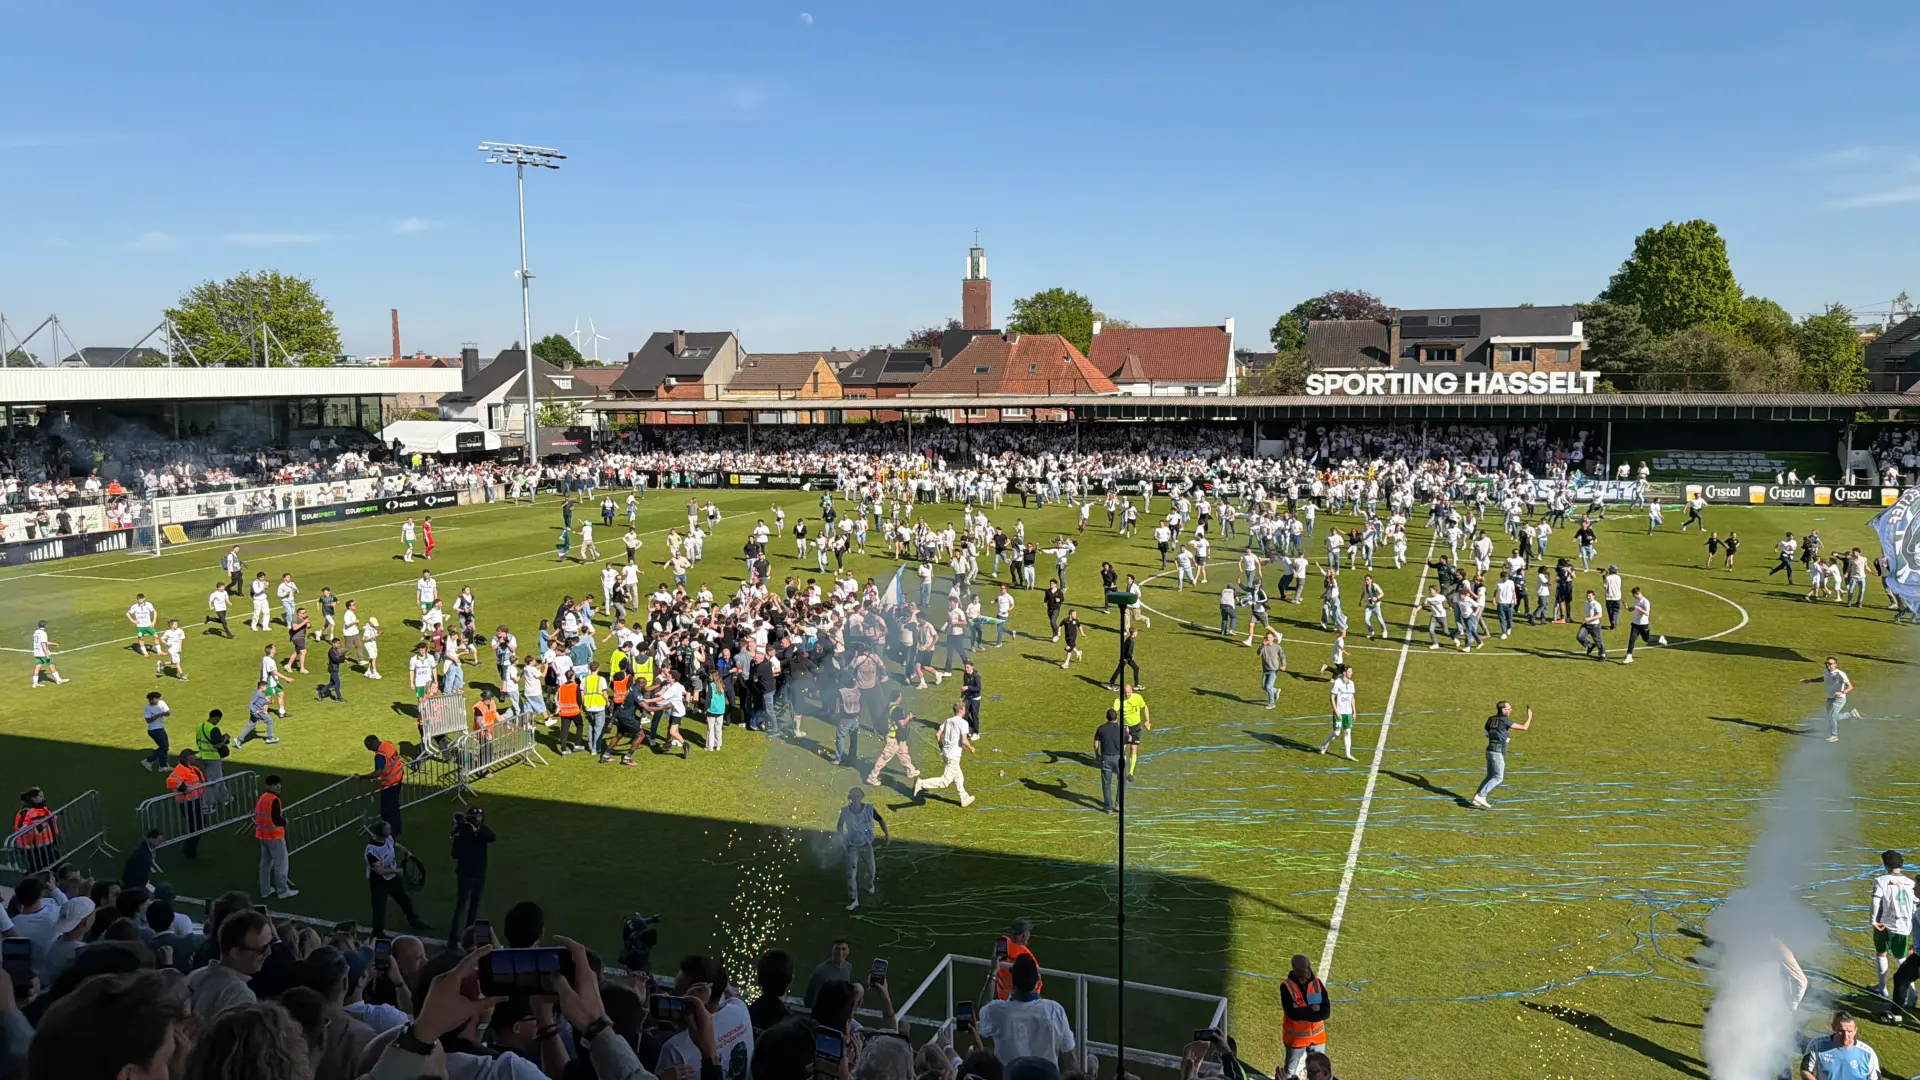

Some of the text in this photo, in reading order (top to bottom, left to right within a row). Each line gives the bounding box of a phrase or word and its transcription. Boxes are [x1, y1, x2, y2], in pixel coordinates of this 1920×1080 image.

[1305, 371, 1600, 395] SPORTING HASSELT
[1705, 485, 1741, 498] Cristal
[1769, 486, 1805, 500] Cristal
[1835, 487, 1872, 501] Cristal
[29, 540, 64, 561] TADAAM
[95, 532, 128, 552] TADAAM
